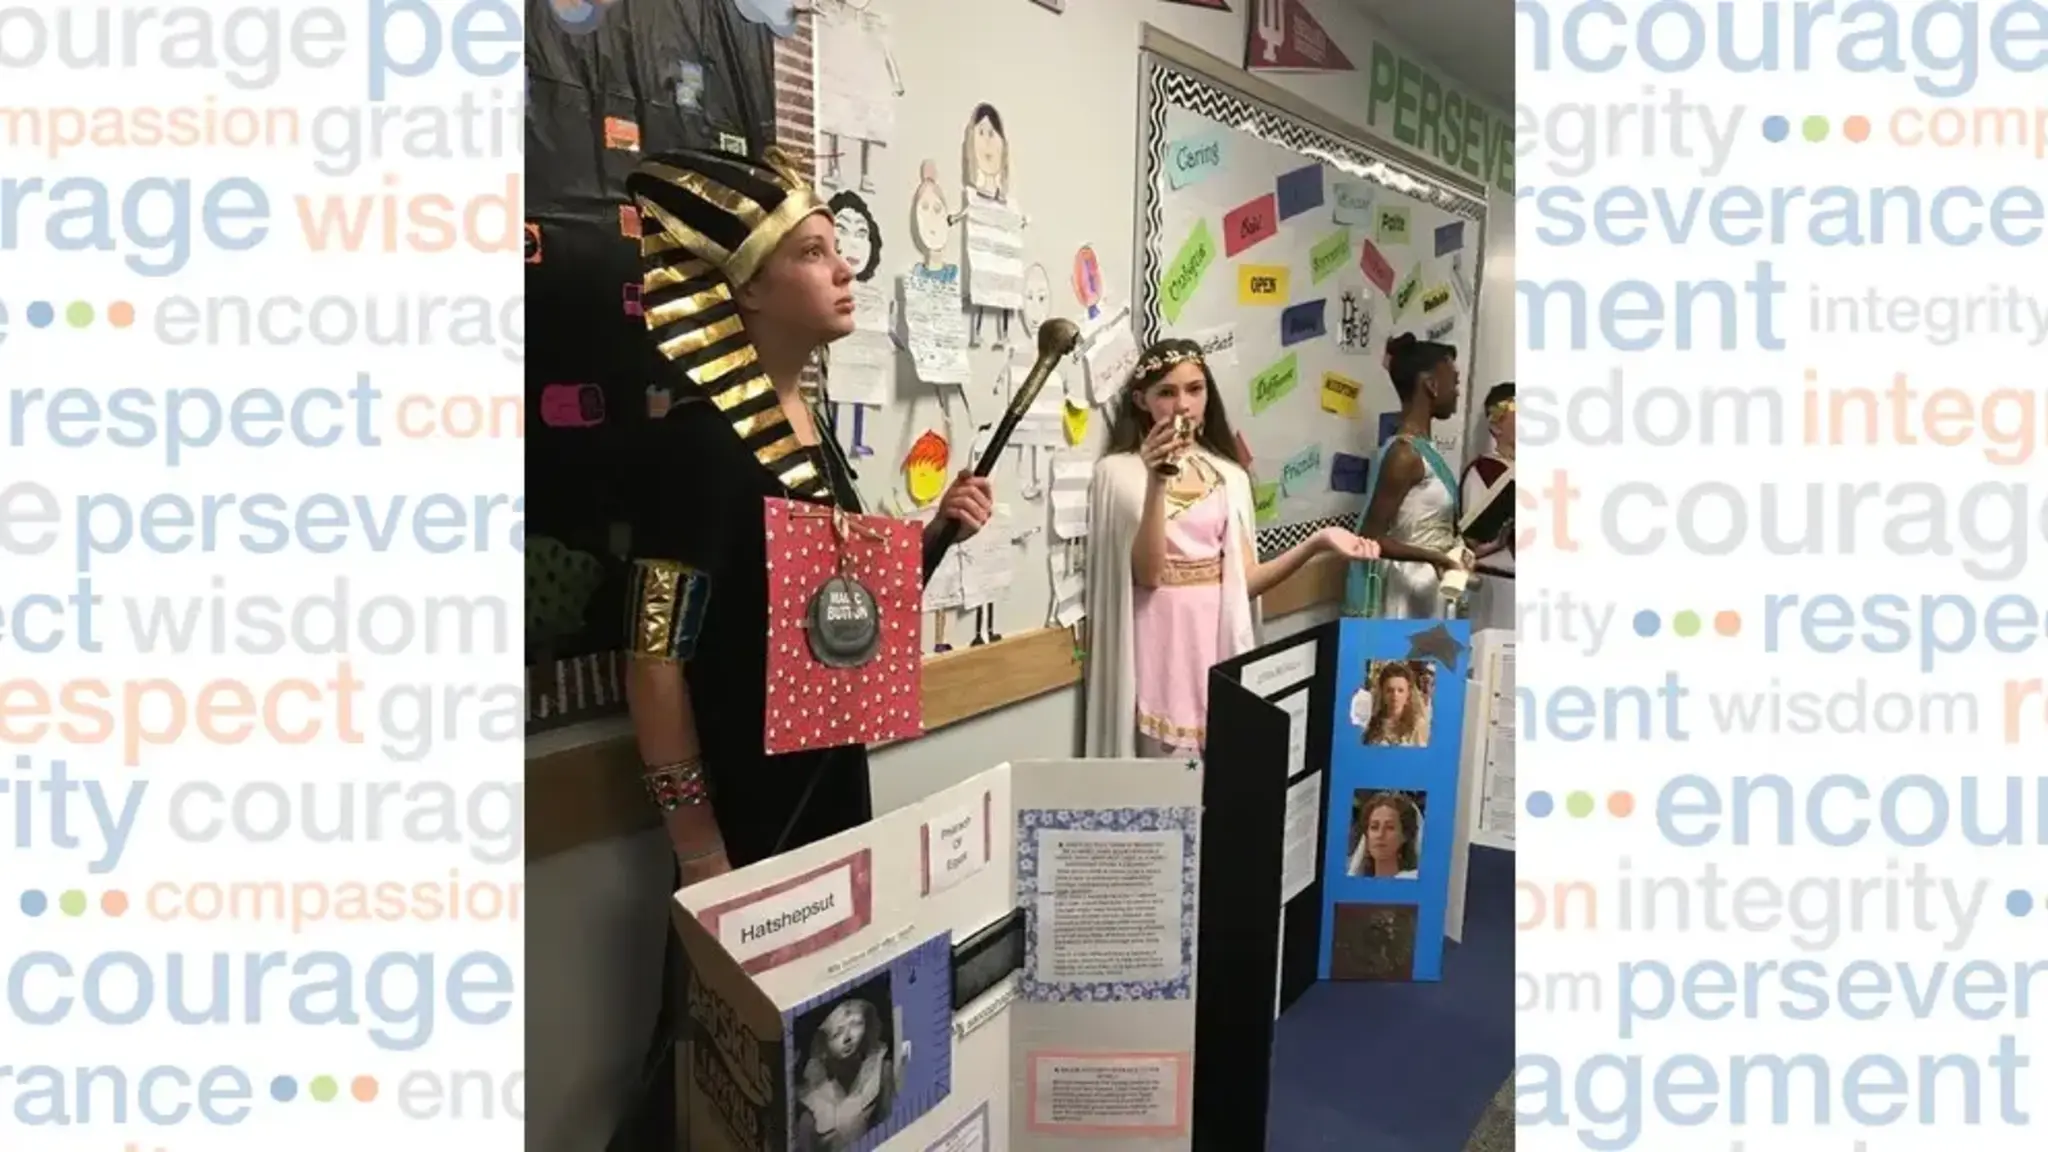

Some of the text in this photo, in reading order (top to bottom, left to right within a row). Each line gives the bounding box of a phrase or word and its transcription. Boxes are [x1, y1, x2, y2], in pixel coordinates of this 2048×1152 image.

[1367, 39, 1514, 195] PERSEVE
[1176, 141, 1220, 171] Caring
[1250, 276, 1276, 294] OPEN
[740, 892, 835, 944] Hatshepsut
